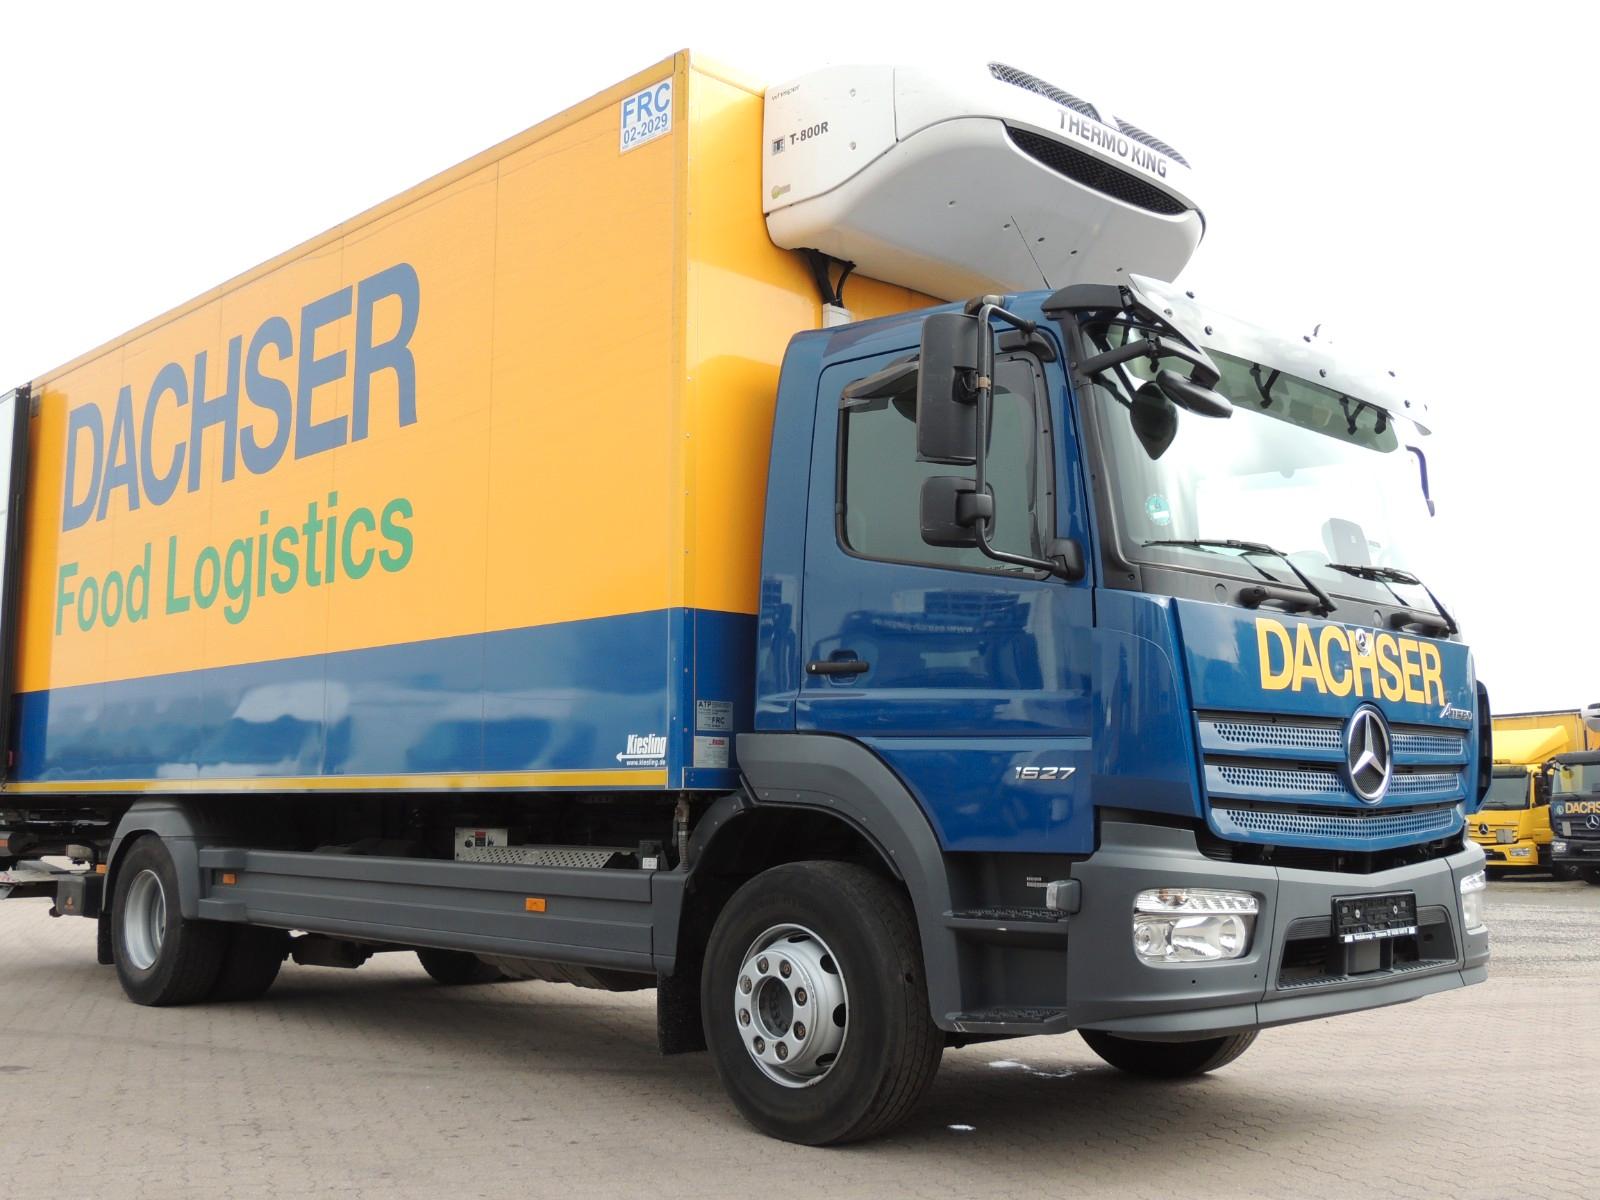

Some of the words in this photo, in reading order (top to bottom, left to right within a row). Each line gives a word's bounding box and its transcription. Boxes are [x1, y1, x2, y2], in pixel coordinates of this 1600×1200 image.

[622, 82, 671, 129] FRC
[623, 112, 669, 145] 02-2029
[789, 121, 830, 146] T-800R
[1057, 108, 1129, 158] THERMO
[1131, 144, 1167, 179] KING
[62, 262, 421, 533] DACHSER
[55, 541, 152, 637] Food
[165, 490, 414, 625] Logistics
[1255, 617, 1446, 707] DACHSER
[711, 716, 725, 724] FRC
[626, 733, 667, 757] Kiesling
[1015, 766, 1076, 780] 1627
